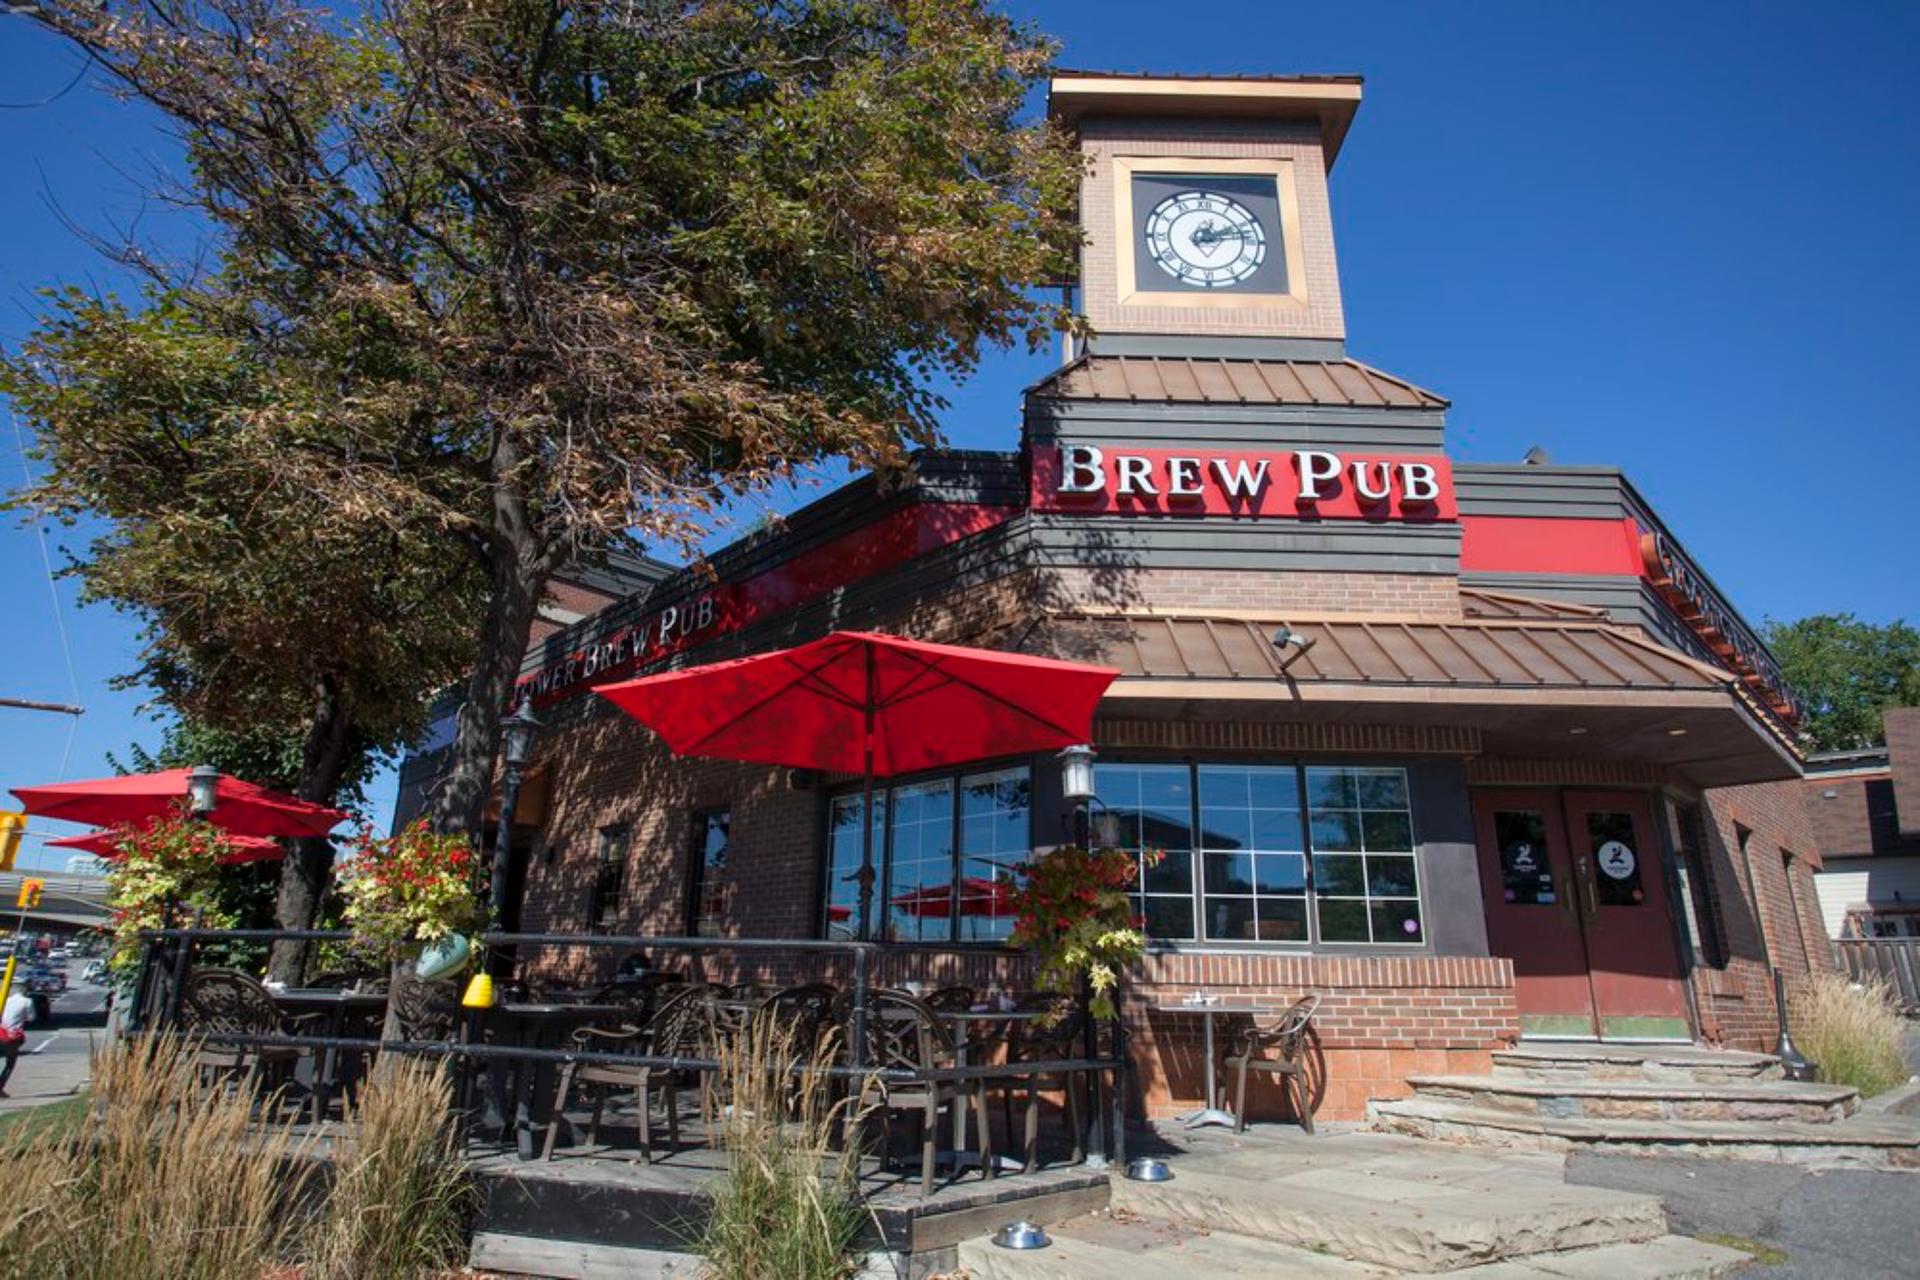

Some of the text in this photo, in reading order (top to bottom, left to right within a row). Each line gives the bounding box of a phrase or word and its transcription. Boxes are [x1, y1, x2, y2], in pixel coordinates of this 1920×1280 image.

[1058, 444, 1440, 500] BREW PUB
[582, 626, 650, 679] BREW
[659, 597, 714, 646] PUB
